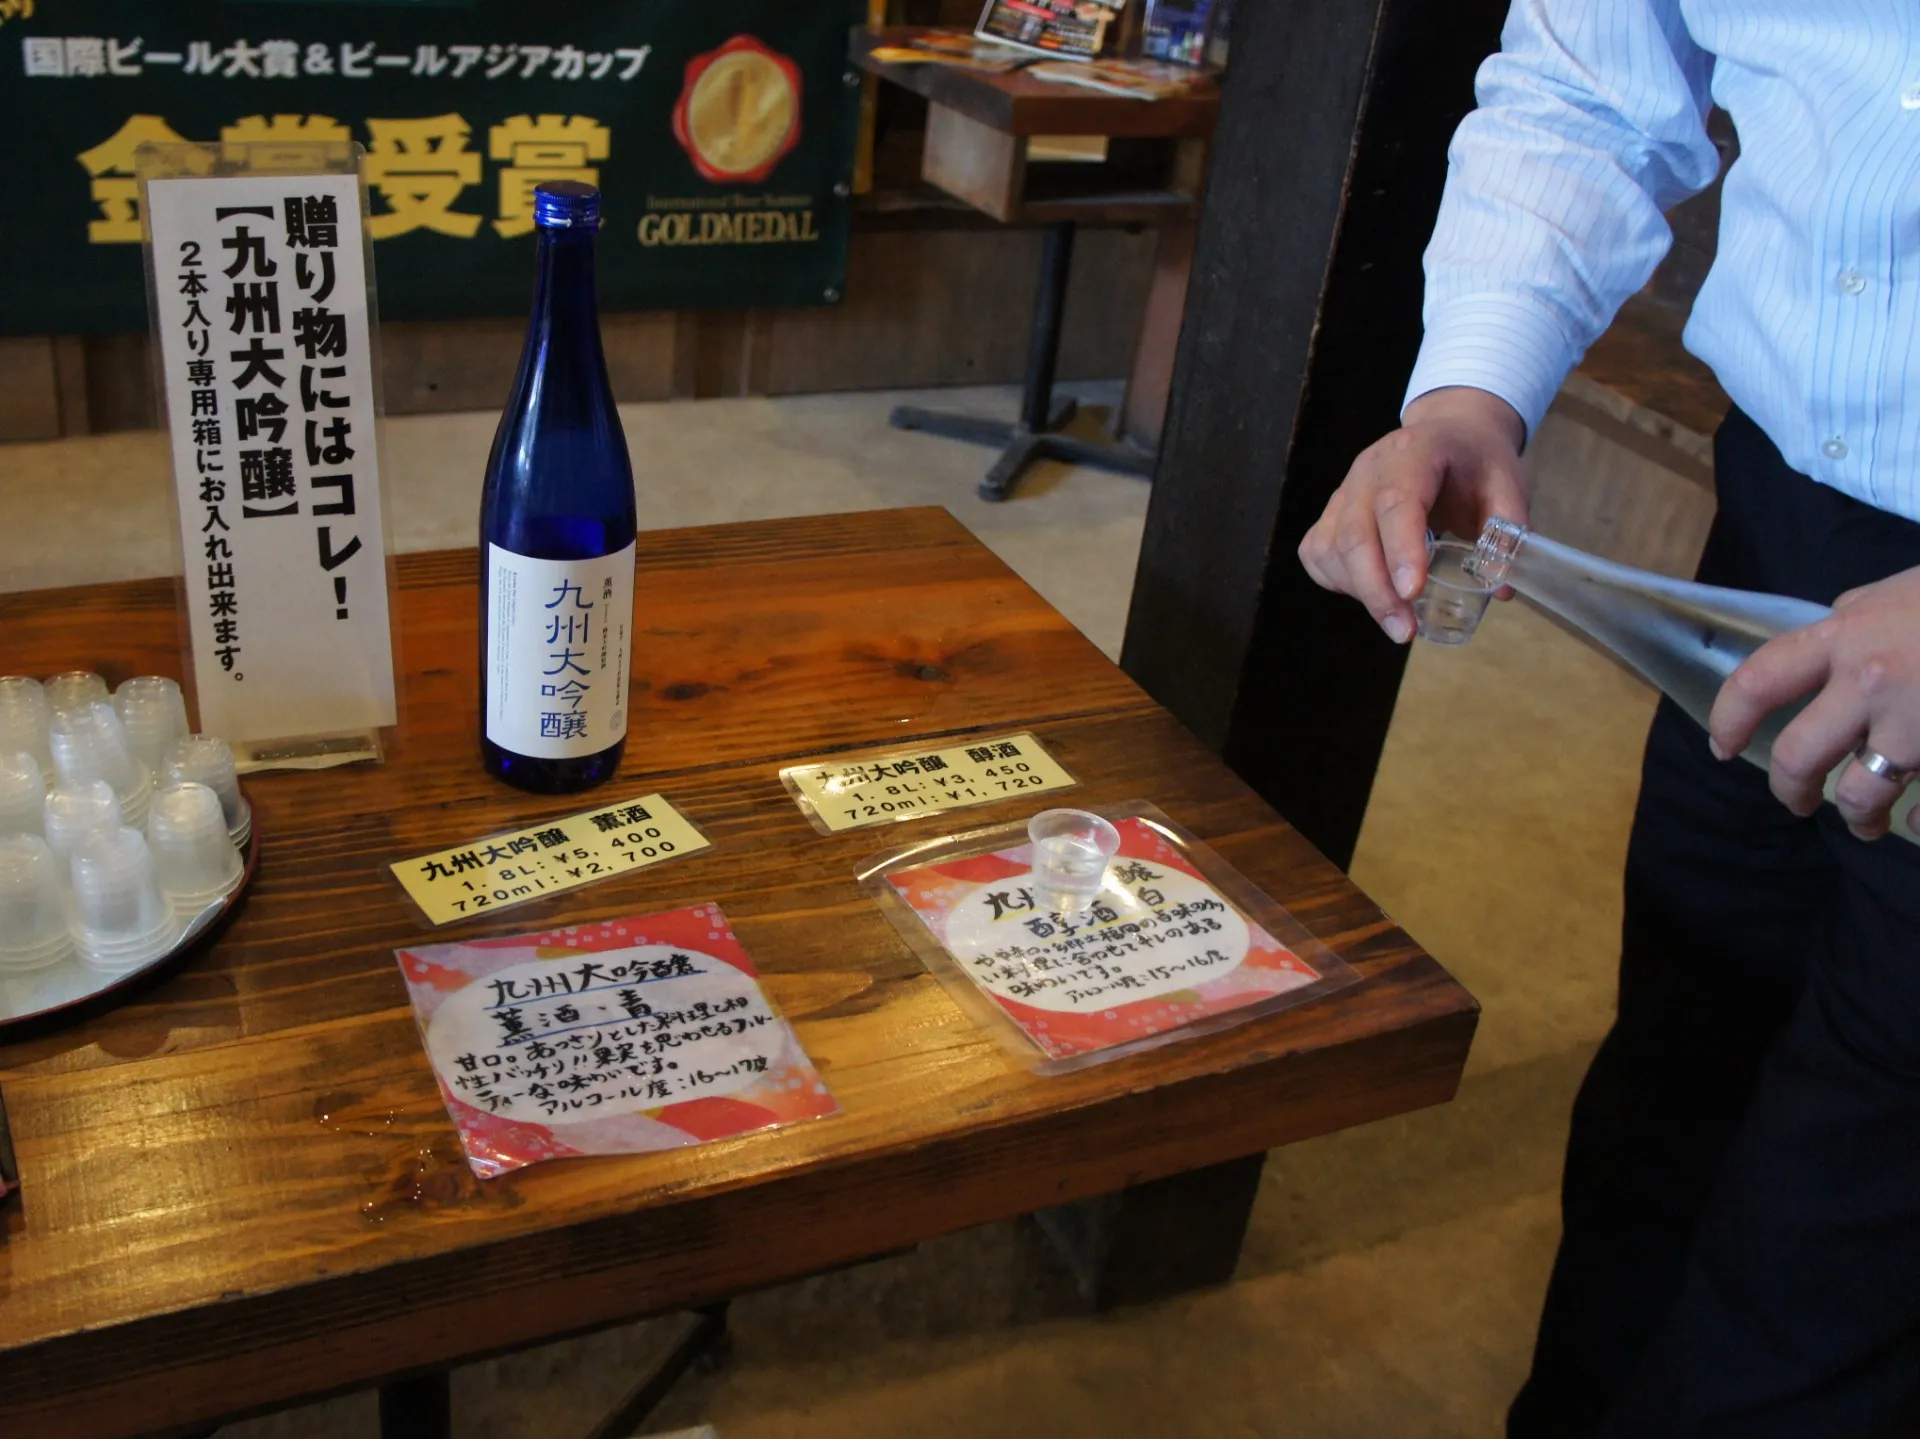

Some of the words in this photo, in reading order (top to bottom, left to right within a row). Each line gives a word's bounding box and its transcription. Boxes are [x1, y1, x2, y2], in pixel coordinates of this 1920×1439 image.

[540, 578, 594, 740] 九州大吟醸
[965, 741, 1023, 764] 醇酒
[420, 827, 571, 881] 九州大吟醸
[588, 804, 653, 833] 薫酒
